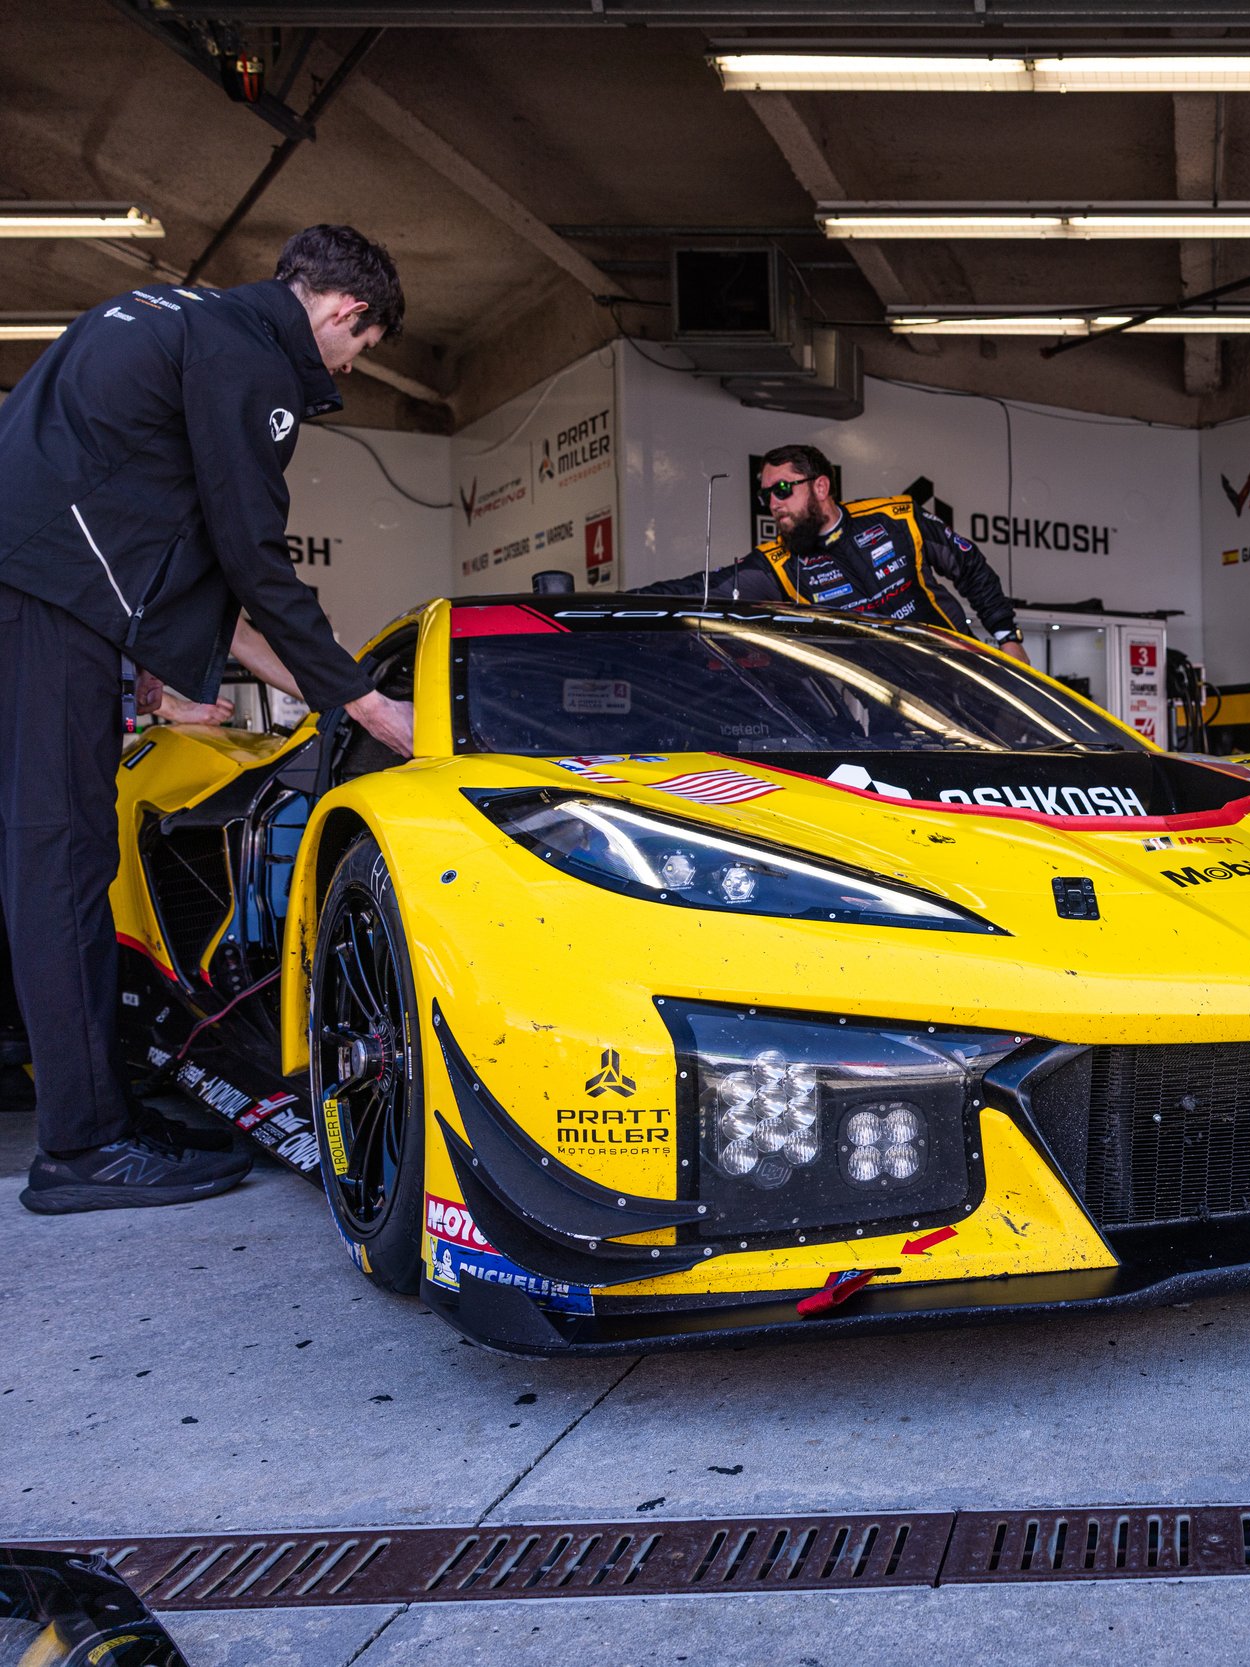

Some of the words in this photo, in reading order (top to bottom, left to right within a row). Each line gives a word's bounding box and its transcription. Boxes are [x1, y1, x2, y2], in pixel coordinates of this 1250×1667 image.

[557, 409, 609, 451] PRATT
[557, 435, 610, 474] MILLER
[473, 487, 526, 518] RACING
[892, 505, 911, 515] OMP
[593, 524, 604, 561] 4
[875, 562, 899, 580] Mobil
[1138, 647, 1149, 665] 3
[939, 786, 1148, 817] OSHKOSH
[1178, 836, 1244, 845] IMSA
[325, 1101, 338, 1118] RF
[557, 1109, 669, 1124] PRATT
[329, 1121, 346, 1162] ROLLER
[557, 1128, 669, 1143] MILLER
[557, 1146, 671, 1155] MOTORSPORTS
[336, 1163, 349, 1175] 4
